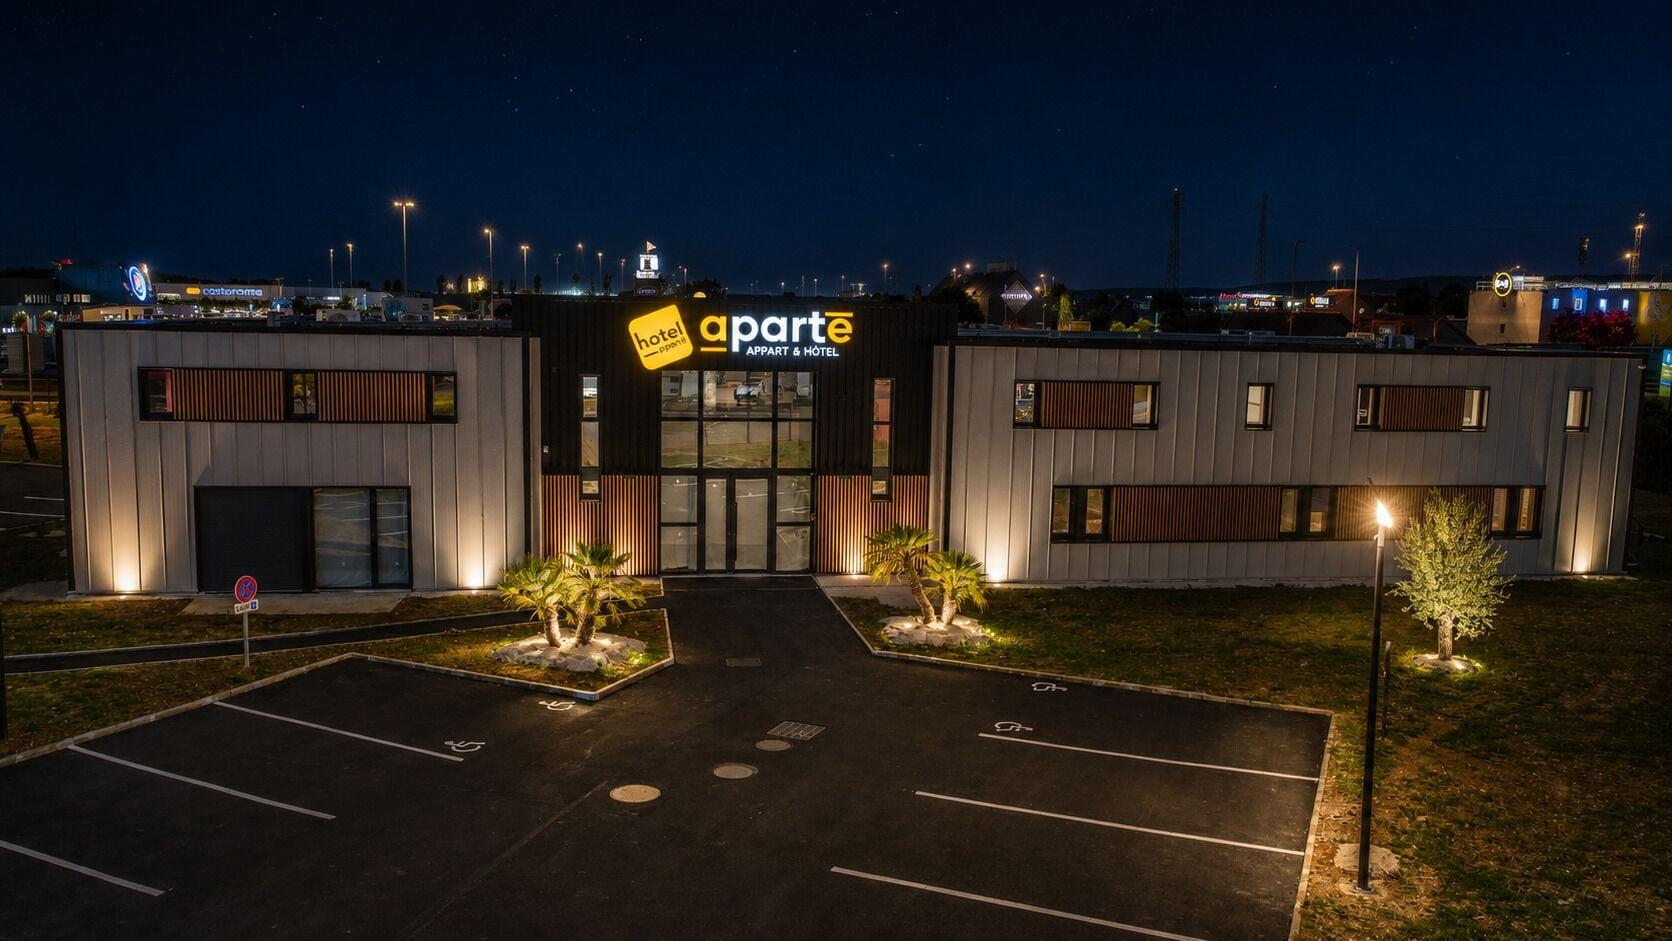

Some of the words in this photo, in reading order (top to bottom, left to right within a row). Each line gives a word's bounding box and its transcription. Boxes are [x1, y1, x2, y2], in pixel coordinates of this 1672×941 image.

[633, 321, 683, 350] hotel
[746, 346, 788, 356] APPART
[793, 346, 800, 357] &
